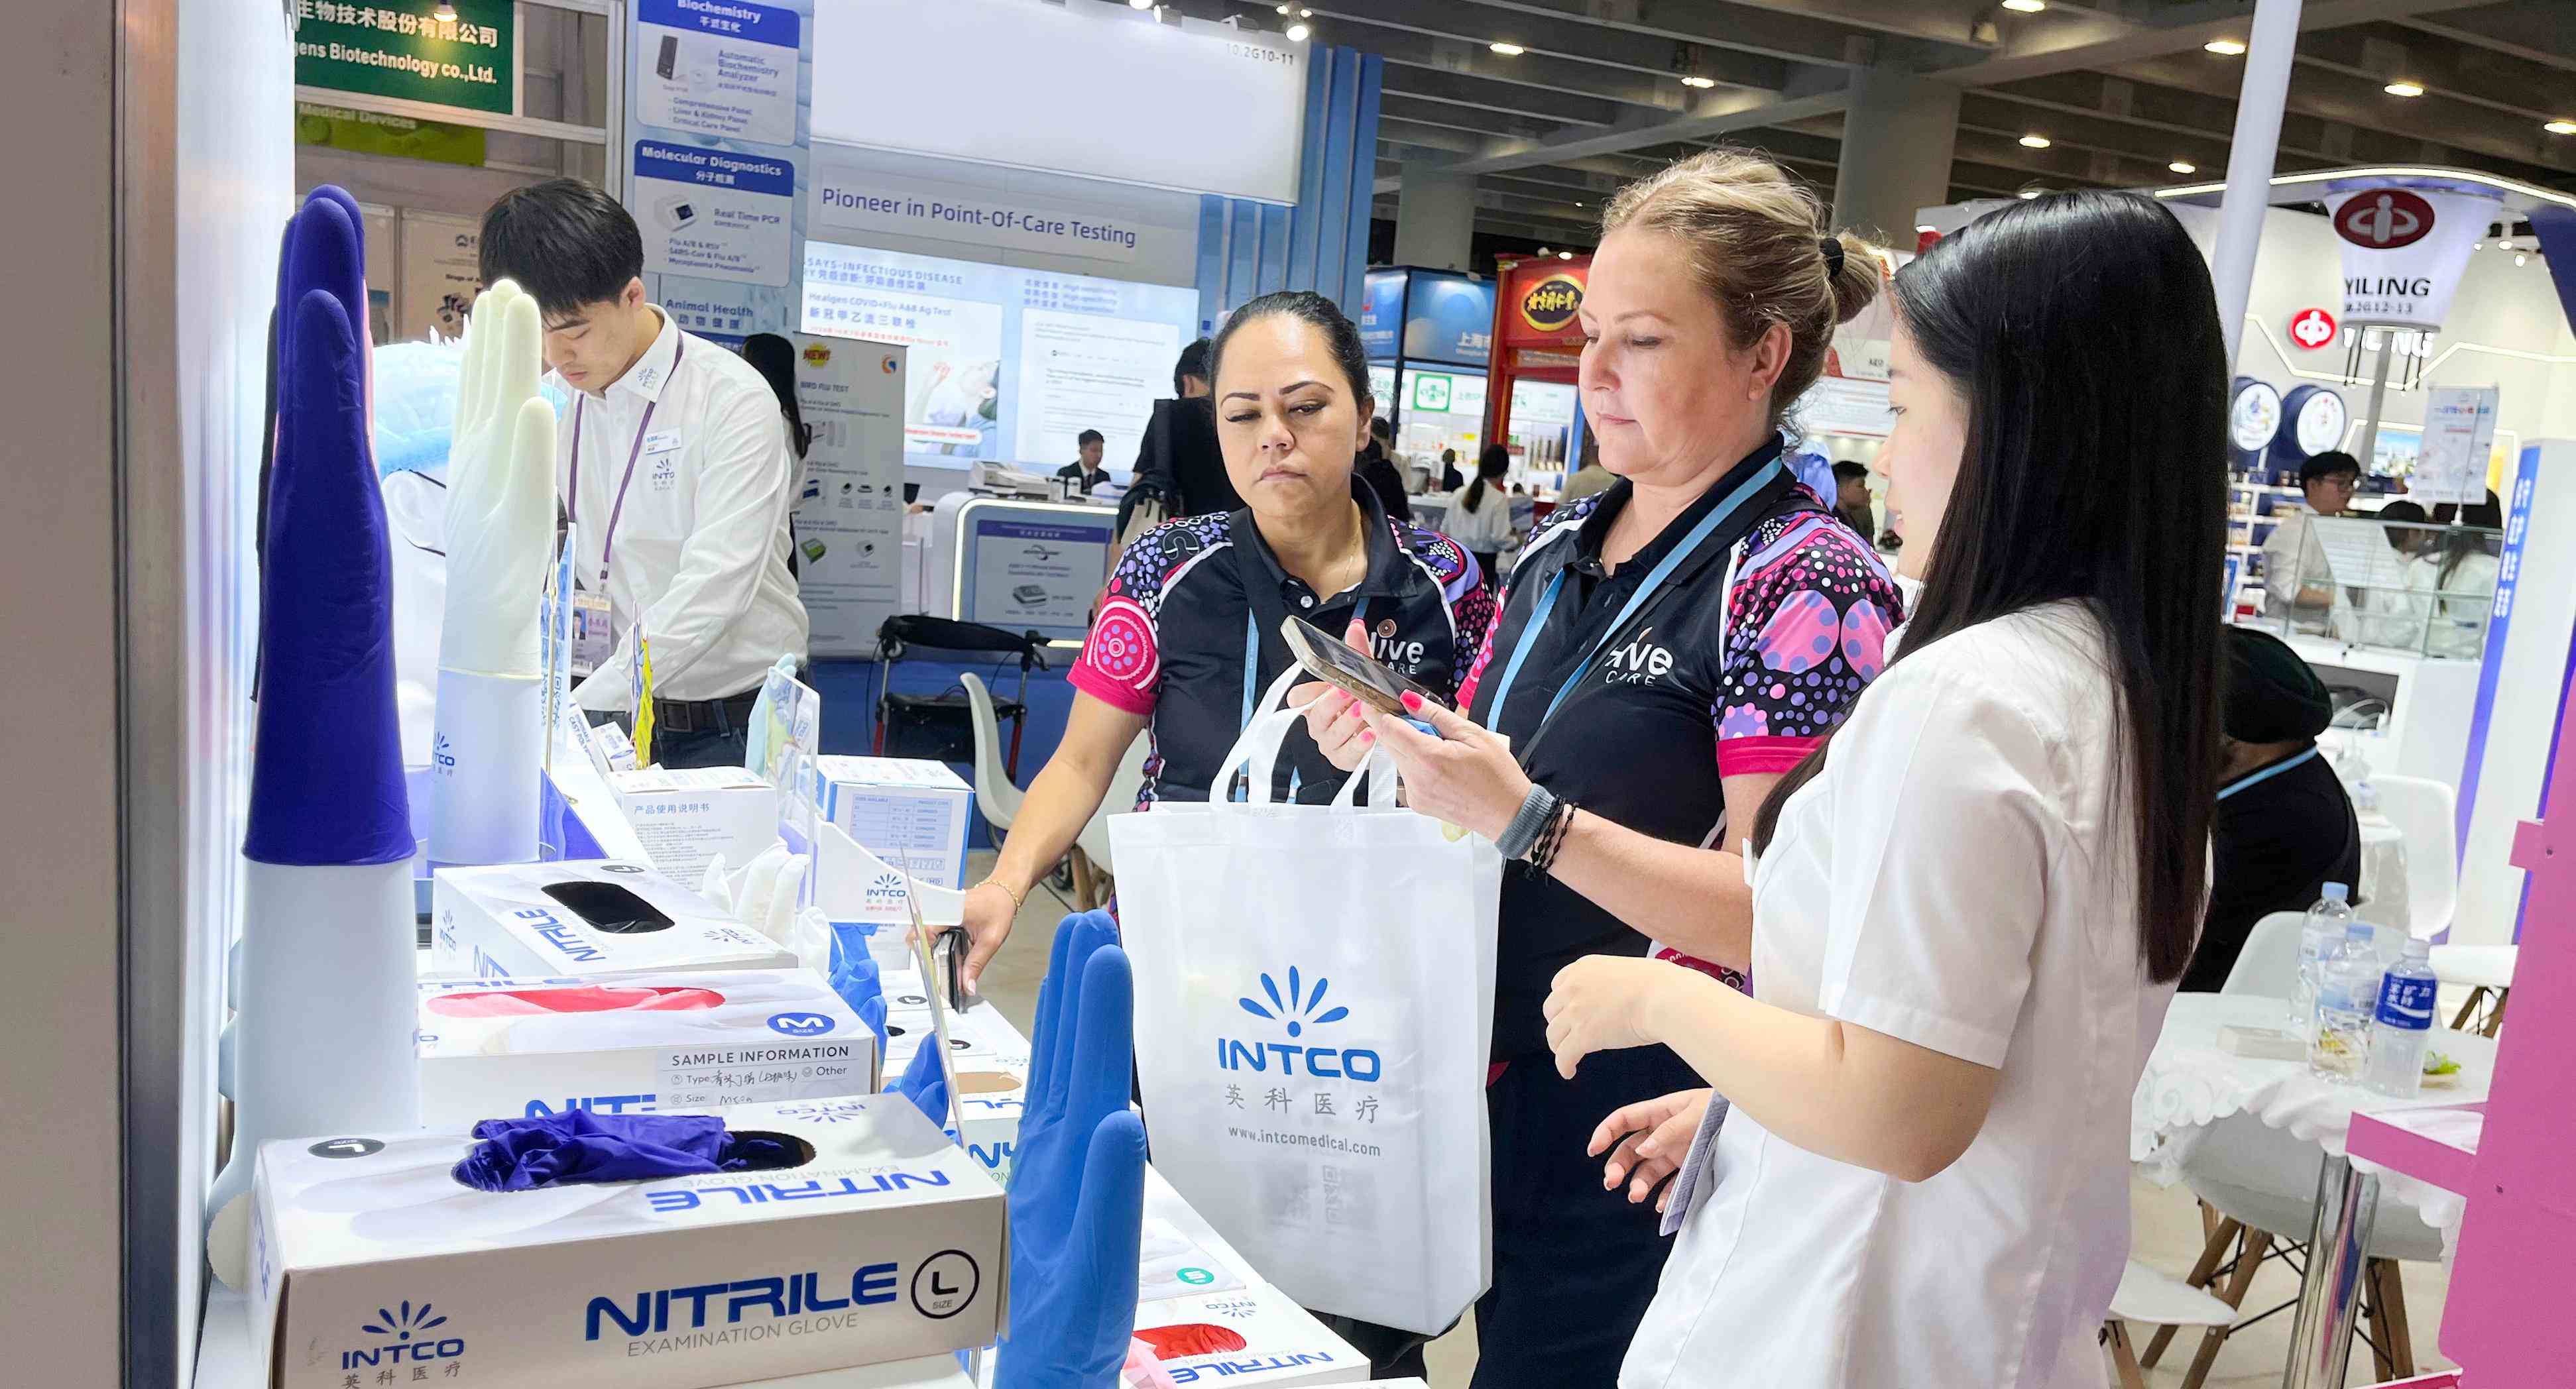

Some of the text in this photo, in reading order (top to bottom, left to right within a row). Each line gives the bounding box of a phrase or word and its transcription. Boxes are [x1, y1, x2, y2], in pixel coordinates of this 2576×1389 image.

[677, 0, 761, 23] Biochemistry
[330, 43, 439, 78] Biotechnology
[642, 146, 782, 176] Molecular Diagnostics
[822, 188, 1136, 249] Pioneer in Point-Of-Care Testing
[804, 258, 963, 285] SAYS-INFECTIOUS DISEASE
[2345, 278, 2431, 296] YILING
[666, 299, 754, 318] Animal Health
[1368, 630, 1425, 665] live
[1387, 661, 1417, 675] ARE
[634, 803, 711, 815] 产品使用说明书
[866, 889, 906, 897] INTCO
[514, 909, 607, 962] NITRILE
[776, 1017, 825, 1028] M
[672, 1046, 849, 1066] SAMPLE INFORMATION
[1218, 1038, 1381, 1082] INTCO
[816, 1066, 847, 1076] Other
[1225, 1083, 1379, 1123] 英科医疗
[1228, 1125, 1381, 1157] www.intcomedical.com
[682, 1164, 900, 1188] EXAMINATION GLOVE
[646, 1170, 951, 1212] NITRILE
[931, 1271, 959, 1296] L
[585, 1262, 898, 1341] NITRILE
[932, 1299, 953, 1309] SIZE
[1206, 1300, 1257, 1309] INTCO
[627, 1313, 858, 1357] EXAMINATION GLOVE
[342, 1338, 464, 1370] INTCO
[1168, 1351, 1334, 1384] NITRILE
[342, 1361, 461, 1389] 英科医疗
